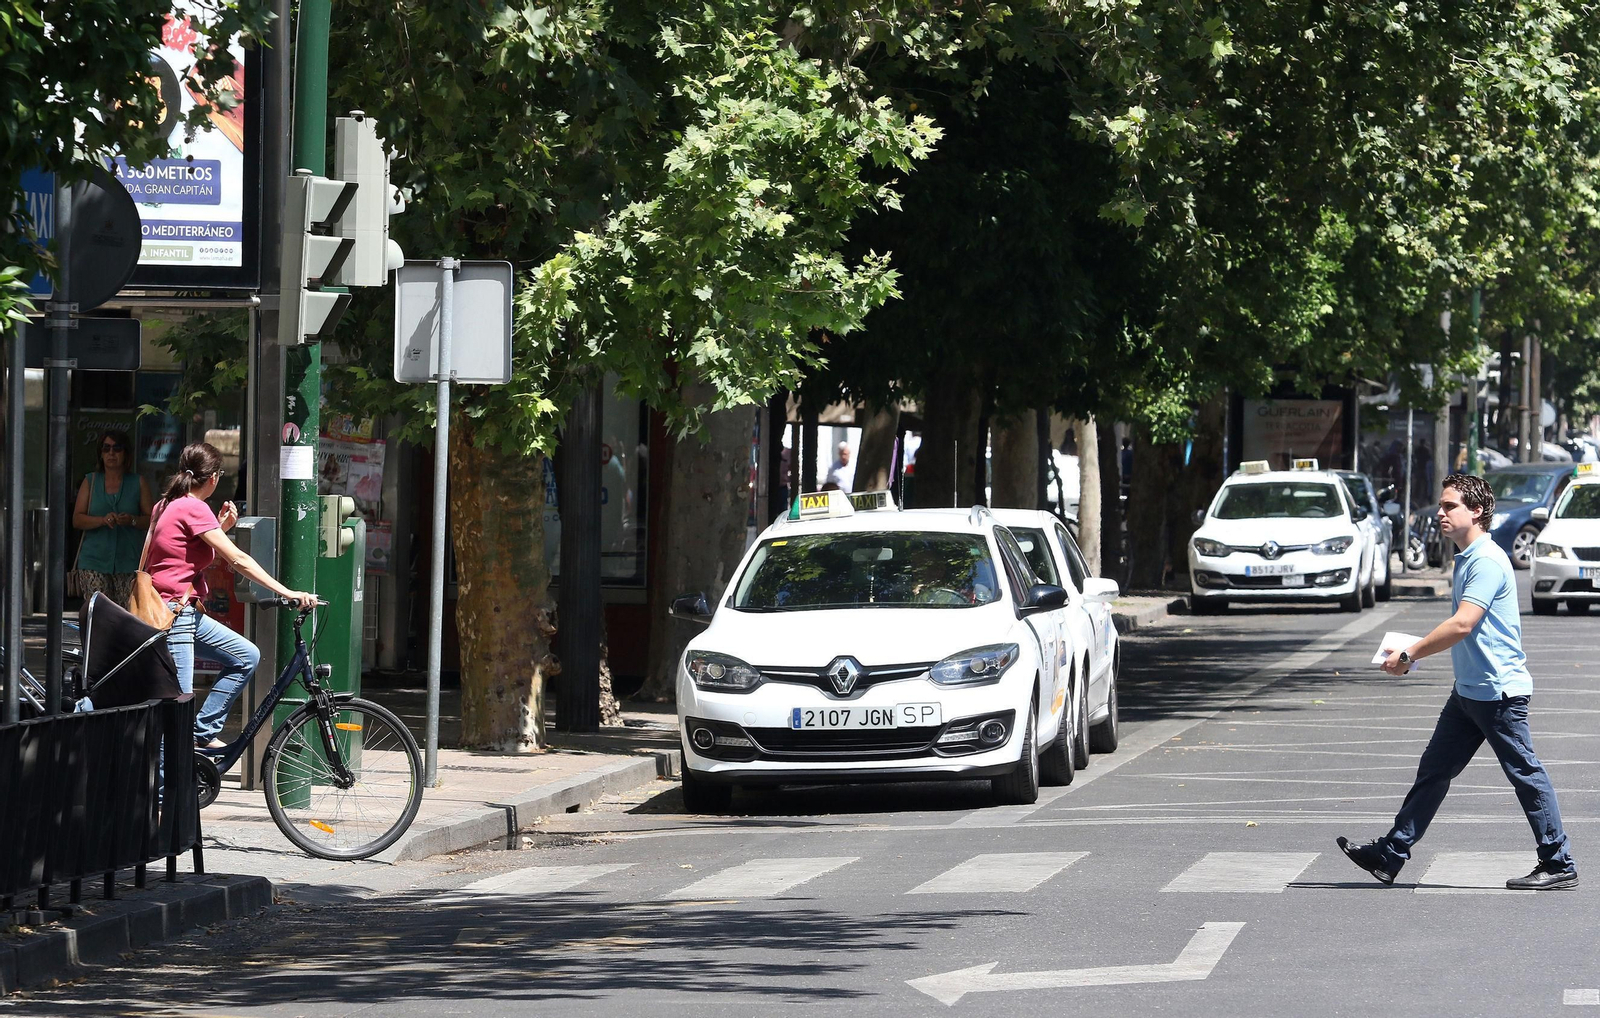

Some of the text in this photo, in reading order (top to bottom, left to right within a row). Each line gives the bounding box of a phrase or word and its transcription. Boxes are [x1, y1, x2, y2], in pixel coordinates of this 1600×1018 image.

[156, 166, 212, 181] METROS
[144, 184, 171, 194] GRAN
[172, 184, 213, 195] CAPITÁN
[152, 224, 234, 237] MEDITERRÁNEO
[150, 249, 189, 258] INFANTIL
[1257, 406, 1330, 417] GUERLAIN
[77, 415, 132, 432] Camping
[801, 495, 829, 510] TAXI
[852, 495, 876, 510] TAXI
[1252, 565, 1275, 574] 8512
[805, 710, 851, 727] 2107
[859, 709, 893, 726] JGN
[903, 706, 934, 724] SP
